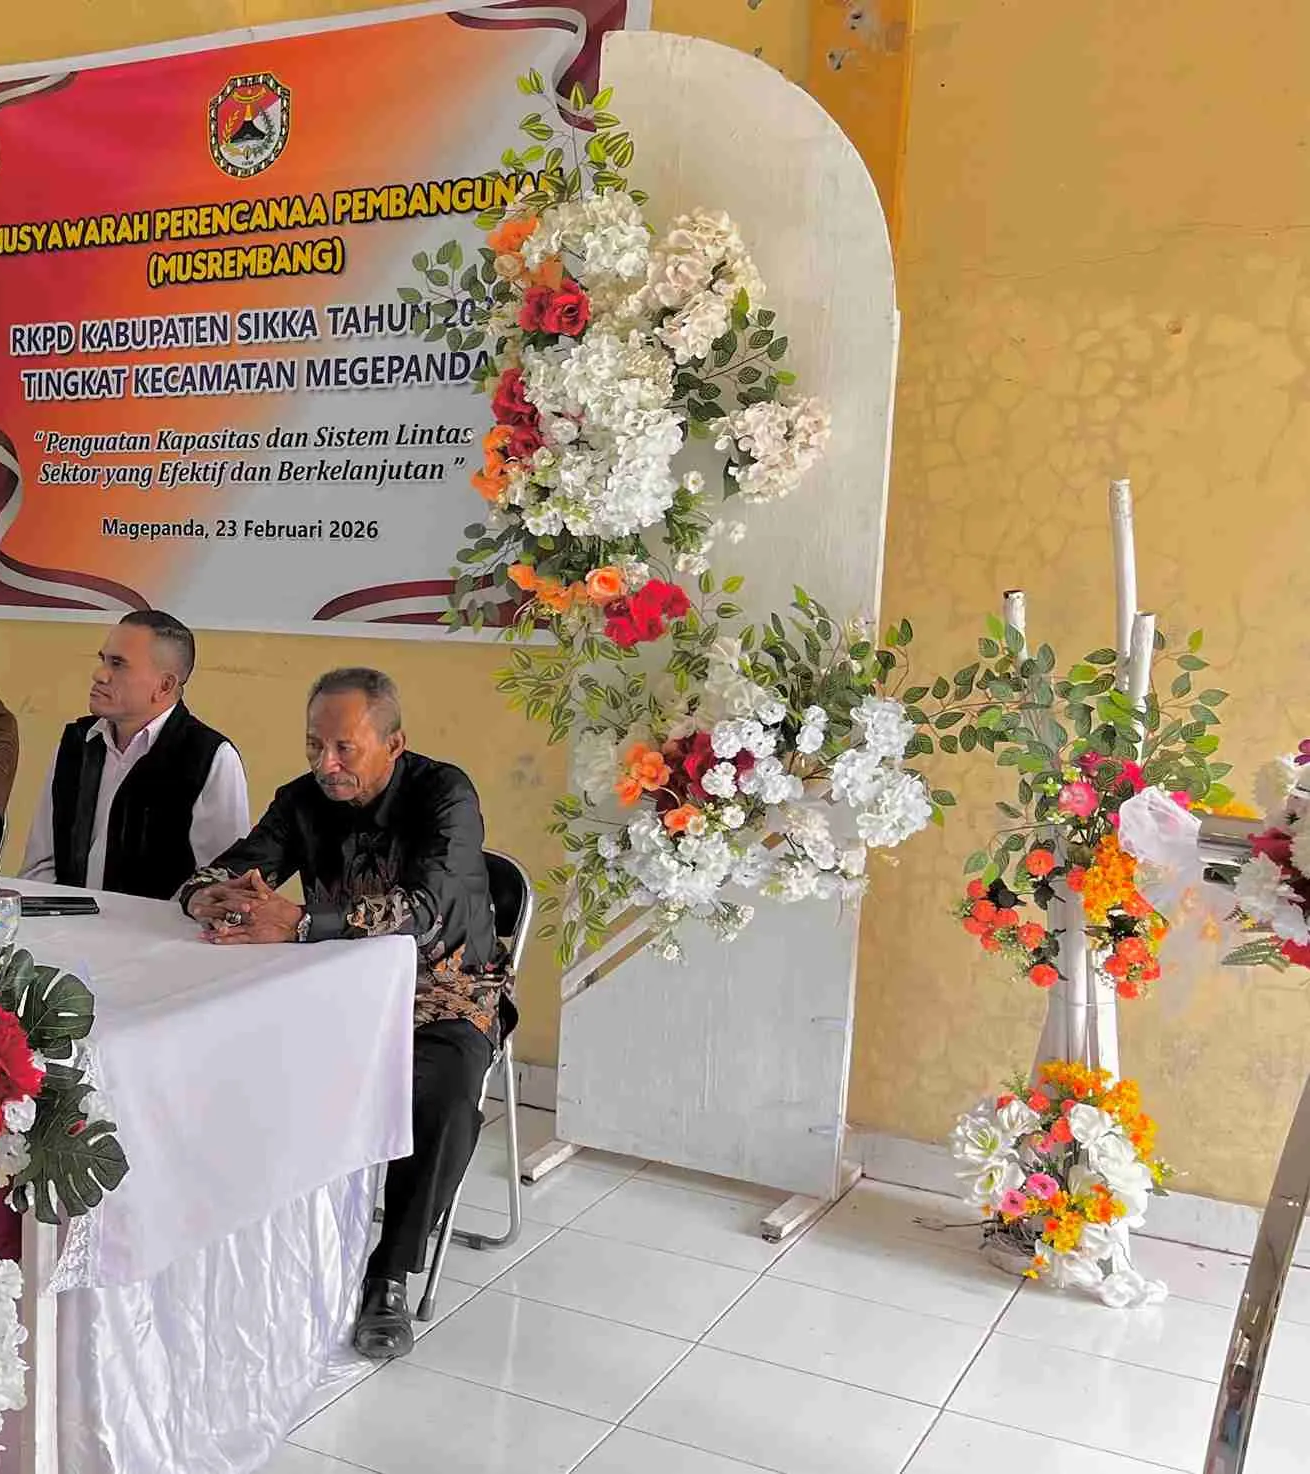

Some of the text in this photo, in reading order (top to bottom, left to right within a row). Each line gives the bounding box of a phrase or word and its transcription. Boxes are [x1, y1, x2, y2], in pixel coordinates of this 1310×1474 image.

[153, 194, 328, 241] PERENCANAA
[147, 238, 344, 288] (MUSREMBANG)
[12, 325, 73, 353] RKPD
[81, 314, 229, 350] KABUPATEN
[237, 308, 318, 341] SIKKA
[23, 368, 126, 398] TINGKAT
[134, 359, 296, 394] KECAMATAN
[156, 429, 260, 454] Kapasitas
[266, 427, 307, 448] dan
[314, 425, 388, 447] Sistem
[396, 423, 474, 445] Lintas
[39, 462, 101, 483] Sektor
[103, 467, 153, 488] yang
[158, 462, 227, 487] Efektif
[230, 461, 271, 483] dan
[277, 458, 444, 487] Berkelanjutan
[102, 518, 379, 540] Magepanda, 23 Februari 2026
